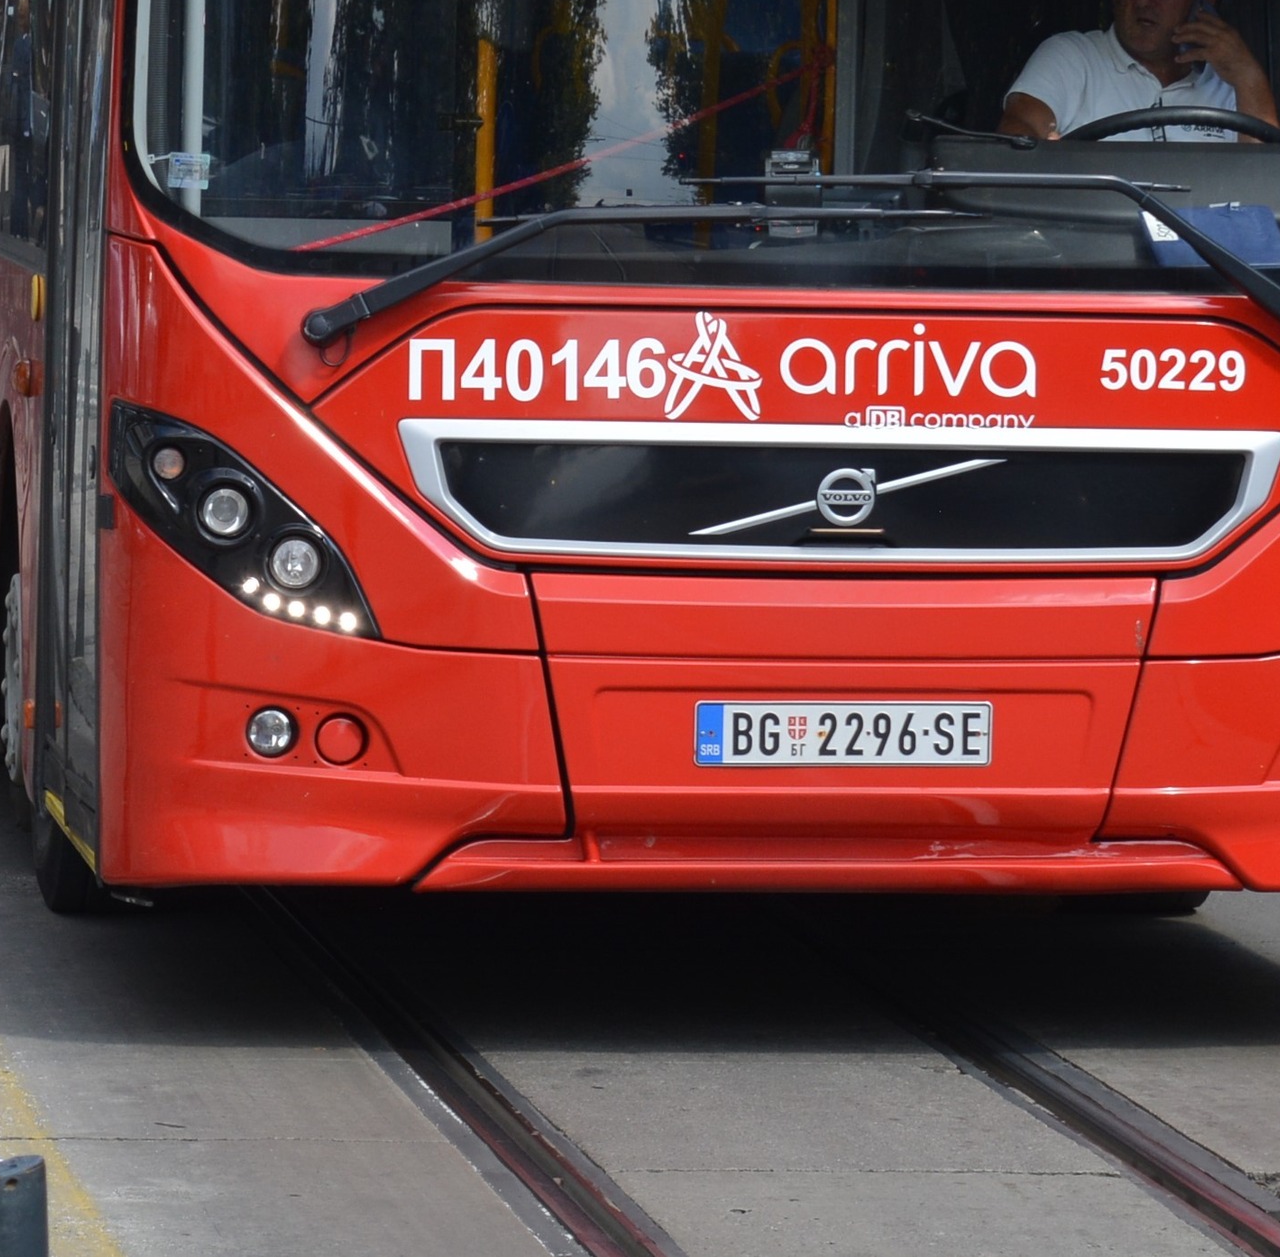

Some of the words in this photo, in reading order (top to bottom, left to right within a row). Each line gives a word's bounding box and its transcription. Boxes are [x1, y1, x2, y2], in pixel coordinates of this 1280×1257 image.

[779, 323, 1037, 398] arriva
[1100, 348, 1246, 393] 50229
[869, 409, 902, 427] DB
[910, 412, 1036, 429] company
[821, 492, 872, 503] VOLVO
[699, 743, 721, 756] SRB
[732, 711, 781, 756] BG
